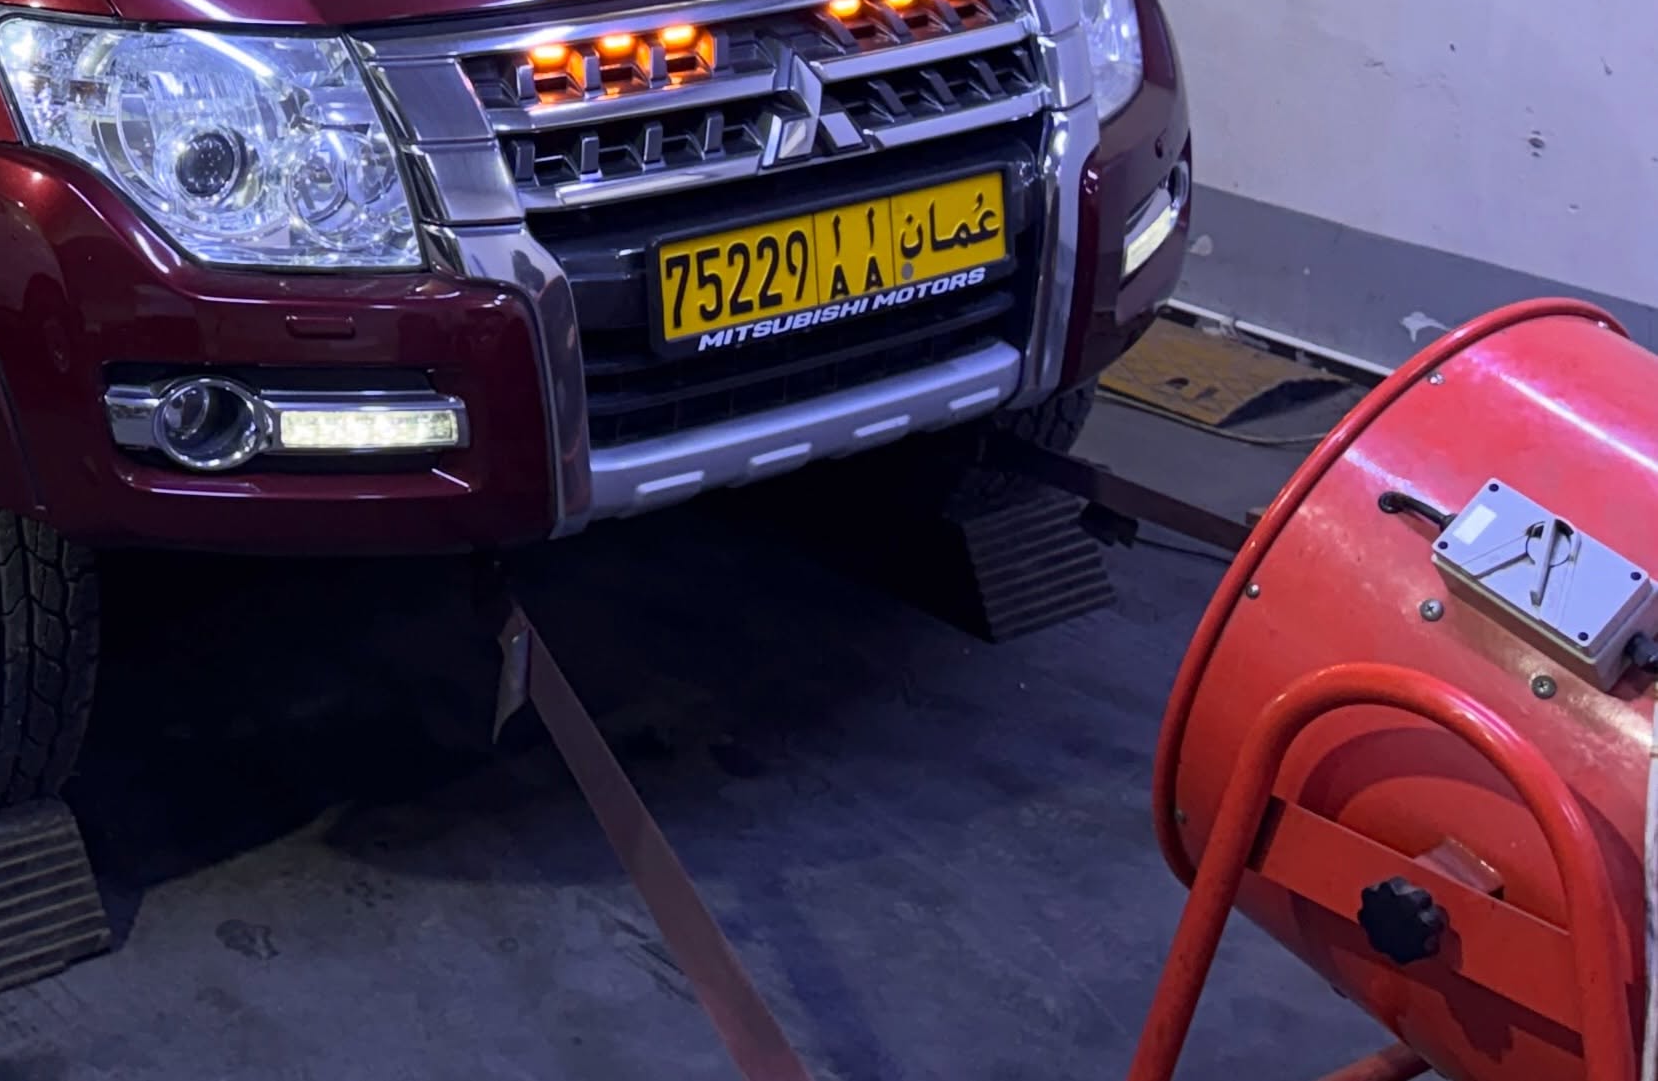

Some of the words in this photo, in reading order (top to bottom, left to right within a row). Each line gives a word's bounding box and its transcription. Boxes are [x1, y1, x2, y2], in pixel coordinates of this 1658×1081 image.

[665, 229, 809, 329] 75229
[698, 298, 869, 351] MITSUBISHI
[873, 266, 987, 308] MOTORS
